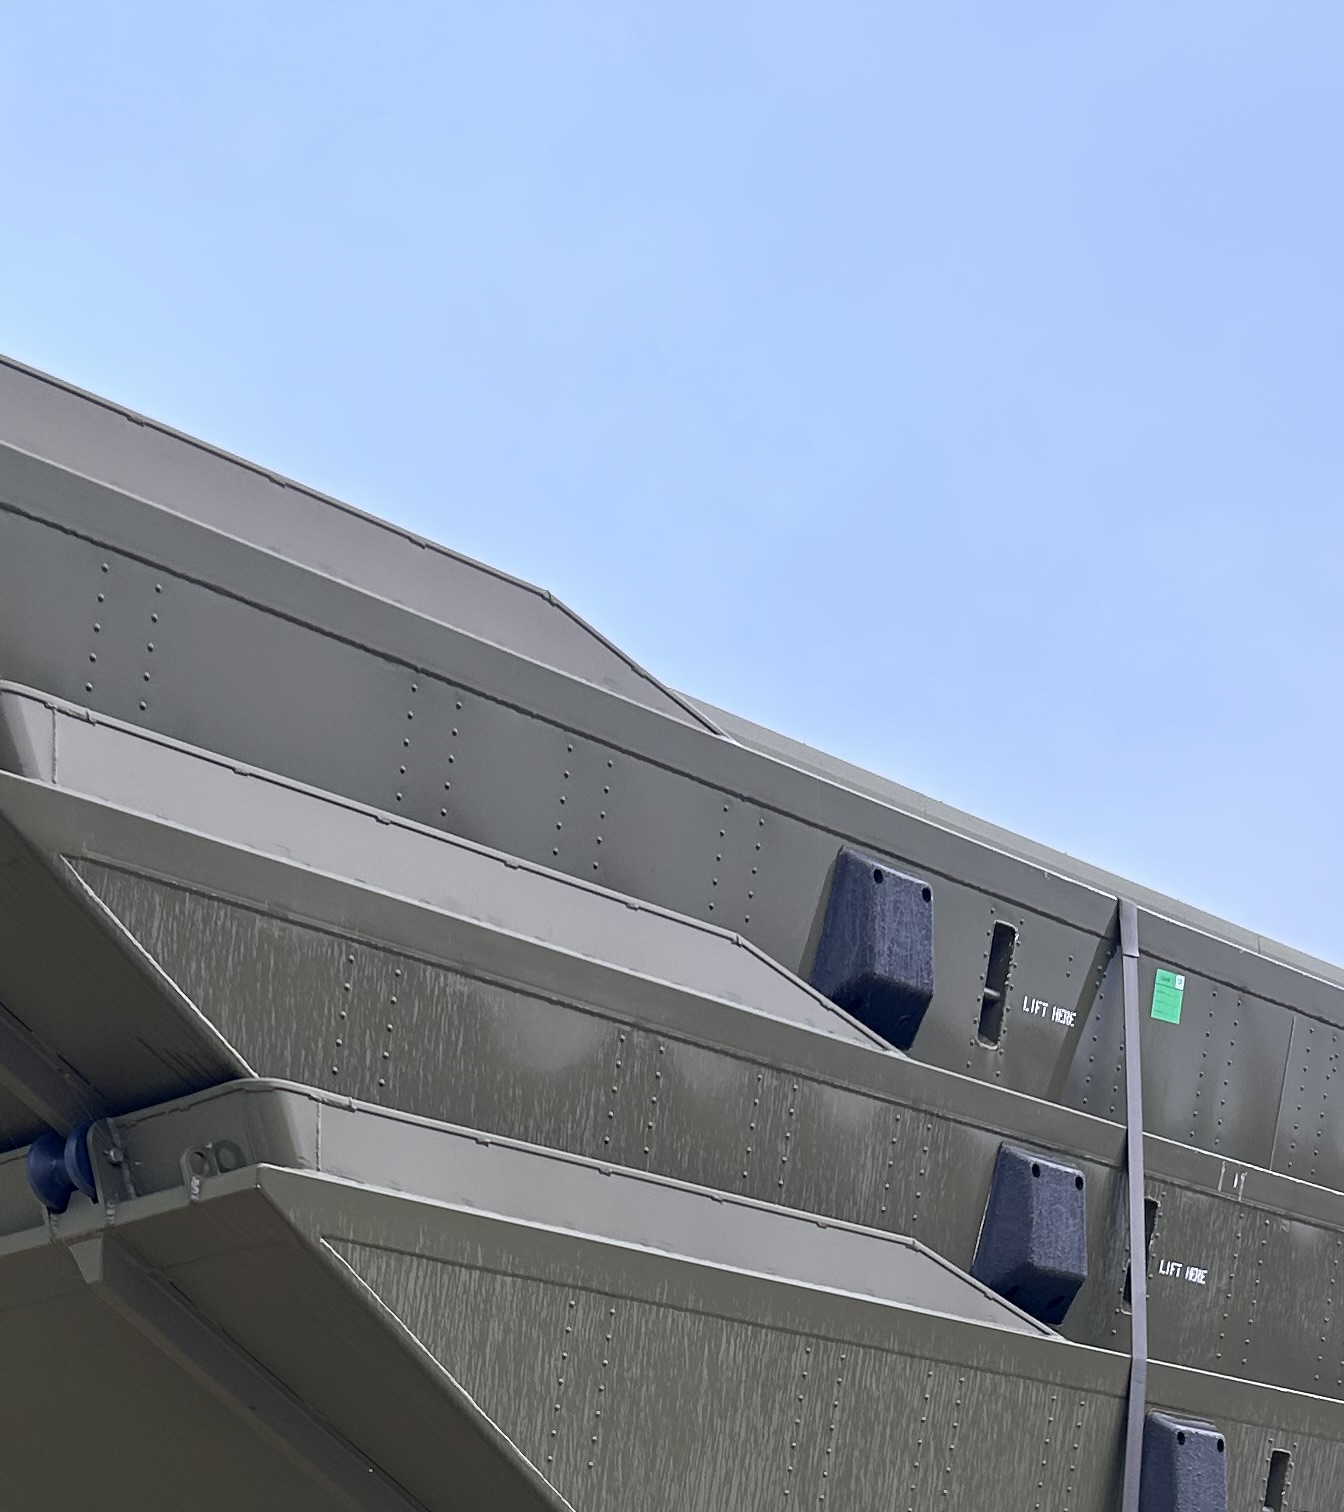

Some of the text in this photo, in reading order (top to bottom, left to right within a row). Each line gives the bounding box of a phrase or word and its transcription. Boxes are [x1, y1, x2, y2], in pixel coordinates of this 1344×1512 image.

[1022, 995, 1077, 1028] LIFT HERE
[1158, 1259, 1208, 1285] LIFT HERE
